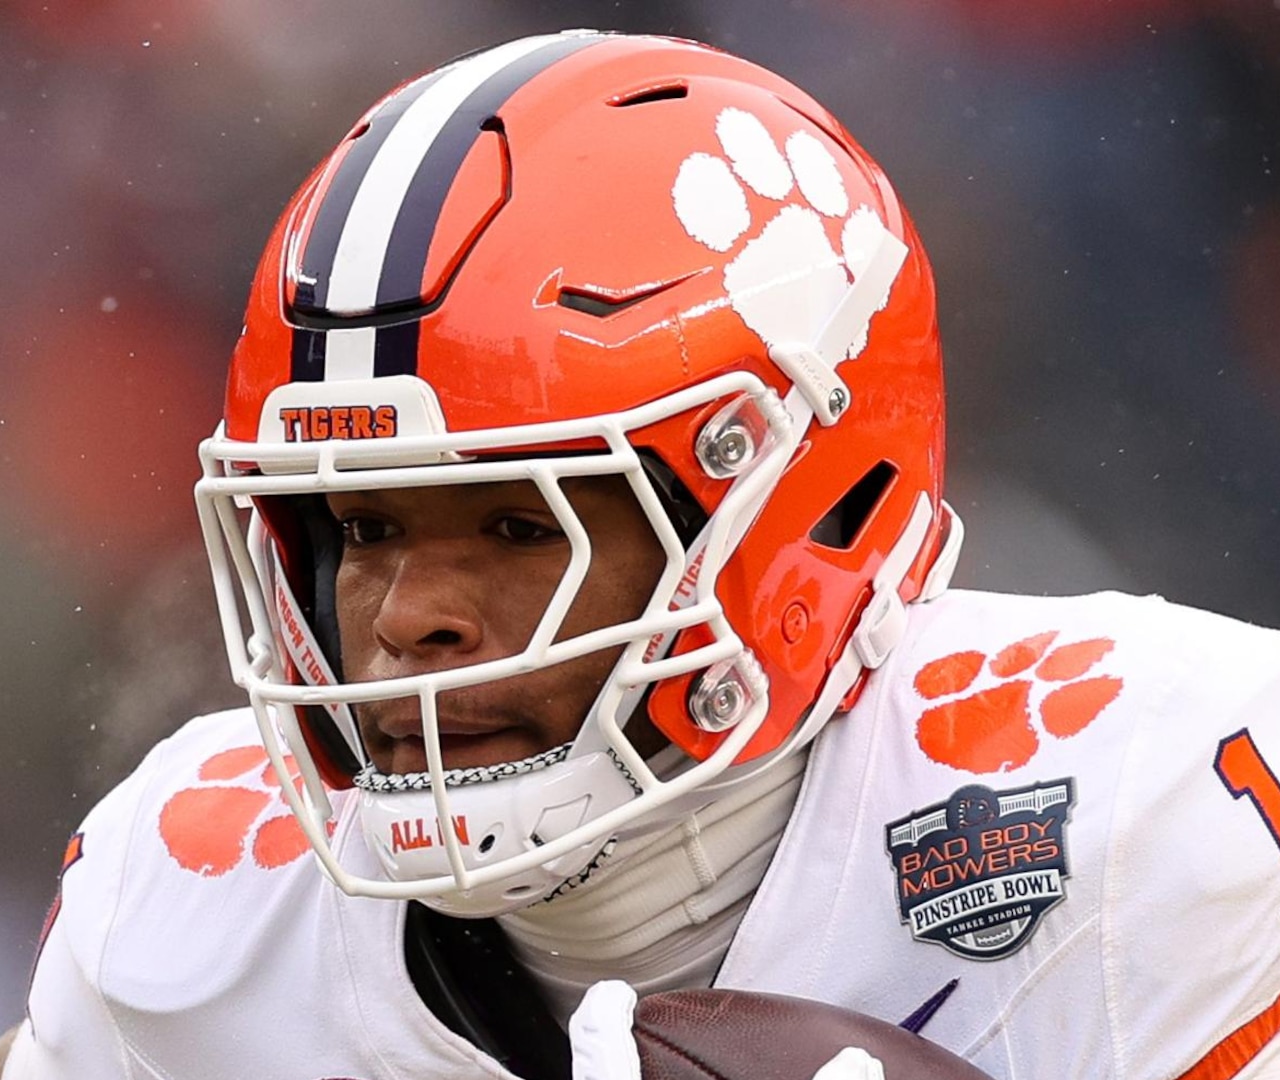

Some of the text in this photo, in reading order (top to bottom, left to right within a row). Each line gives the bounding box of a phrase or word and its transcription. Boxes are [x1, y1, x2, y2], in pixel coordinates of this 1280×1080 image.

[280, 405, 397, 442] TIGERS
[391, 814, 470, 854] ALL N
[901, 817, 1056, 875] BAD BOY
[902, 838, 1060, 898] MOWERS
[913, 874, 1059, 931] PINSTRIPE BOWL
[946, 904, 1032, 935] YANKEE STADIUM
